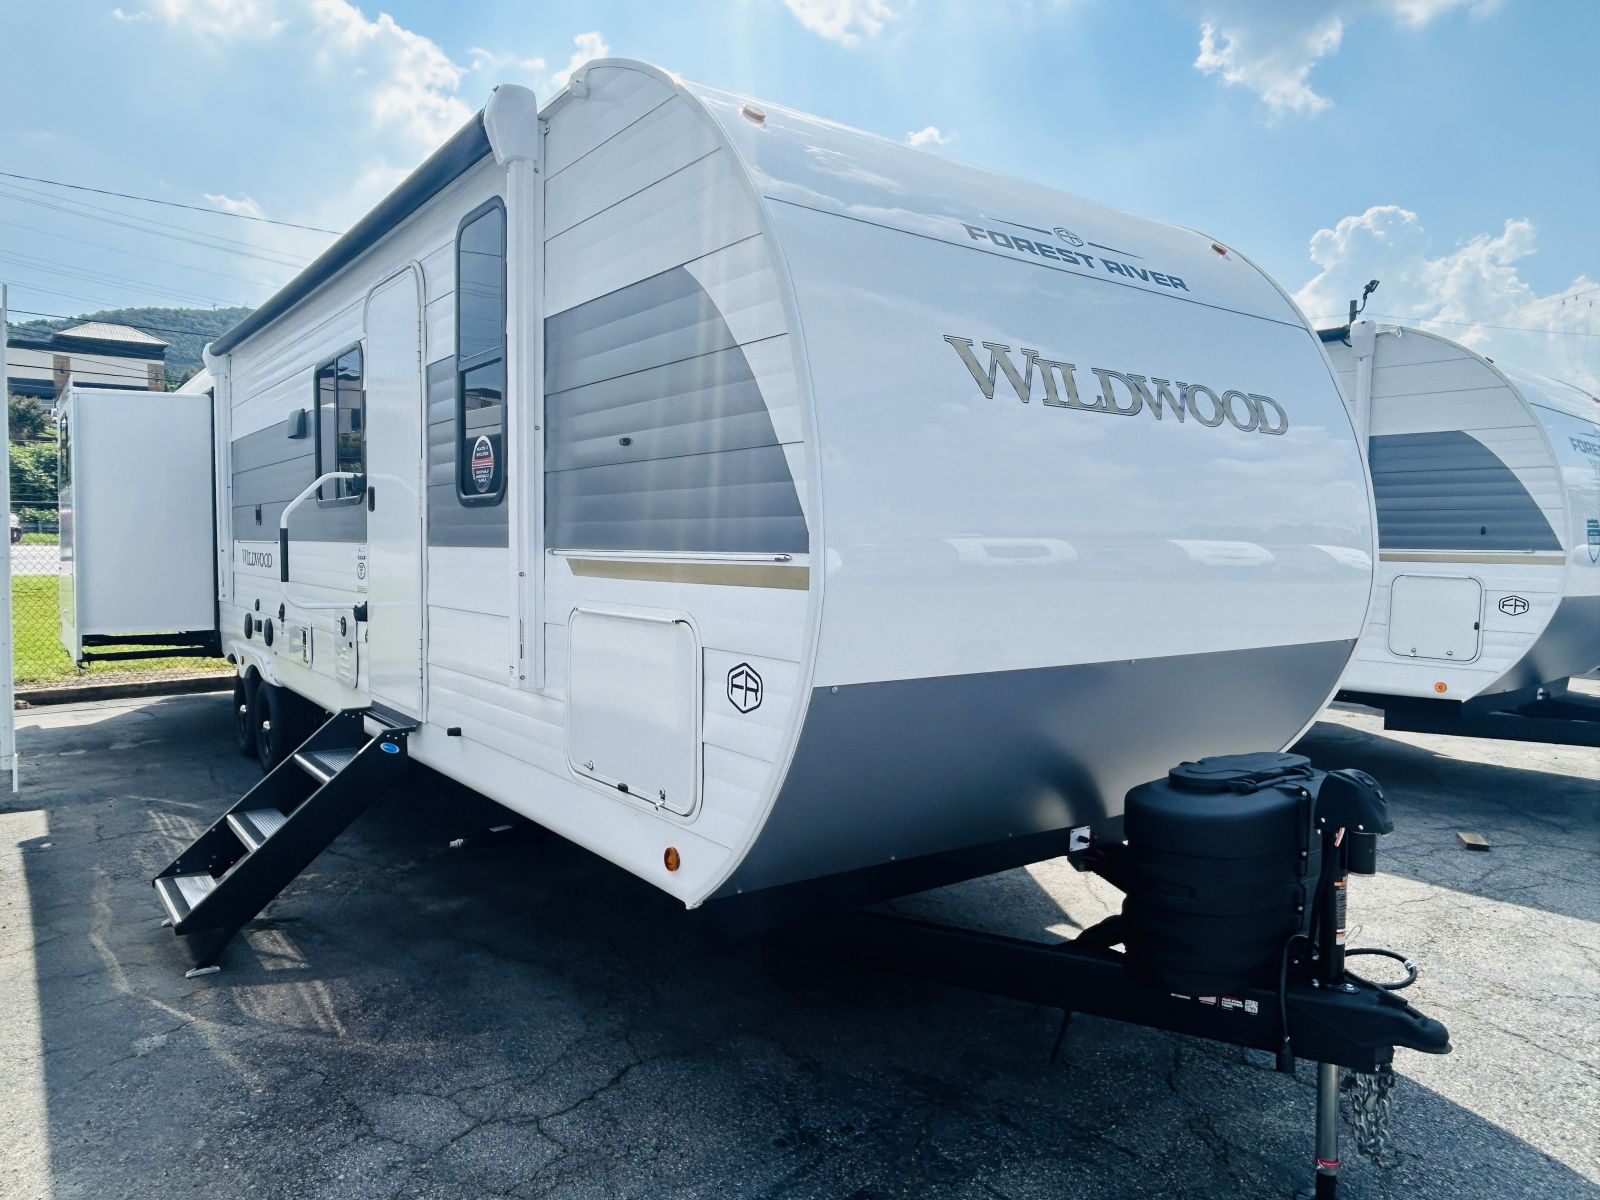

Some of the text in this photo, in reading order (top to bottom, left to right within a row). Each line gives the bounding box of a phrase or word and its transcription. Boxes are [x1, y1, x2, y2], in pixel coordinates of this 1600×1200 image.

[960, 223, 1190, 291] FOREST RIVER
[943, 334, 1289, 435] WILDWOOD
